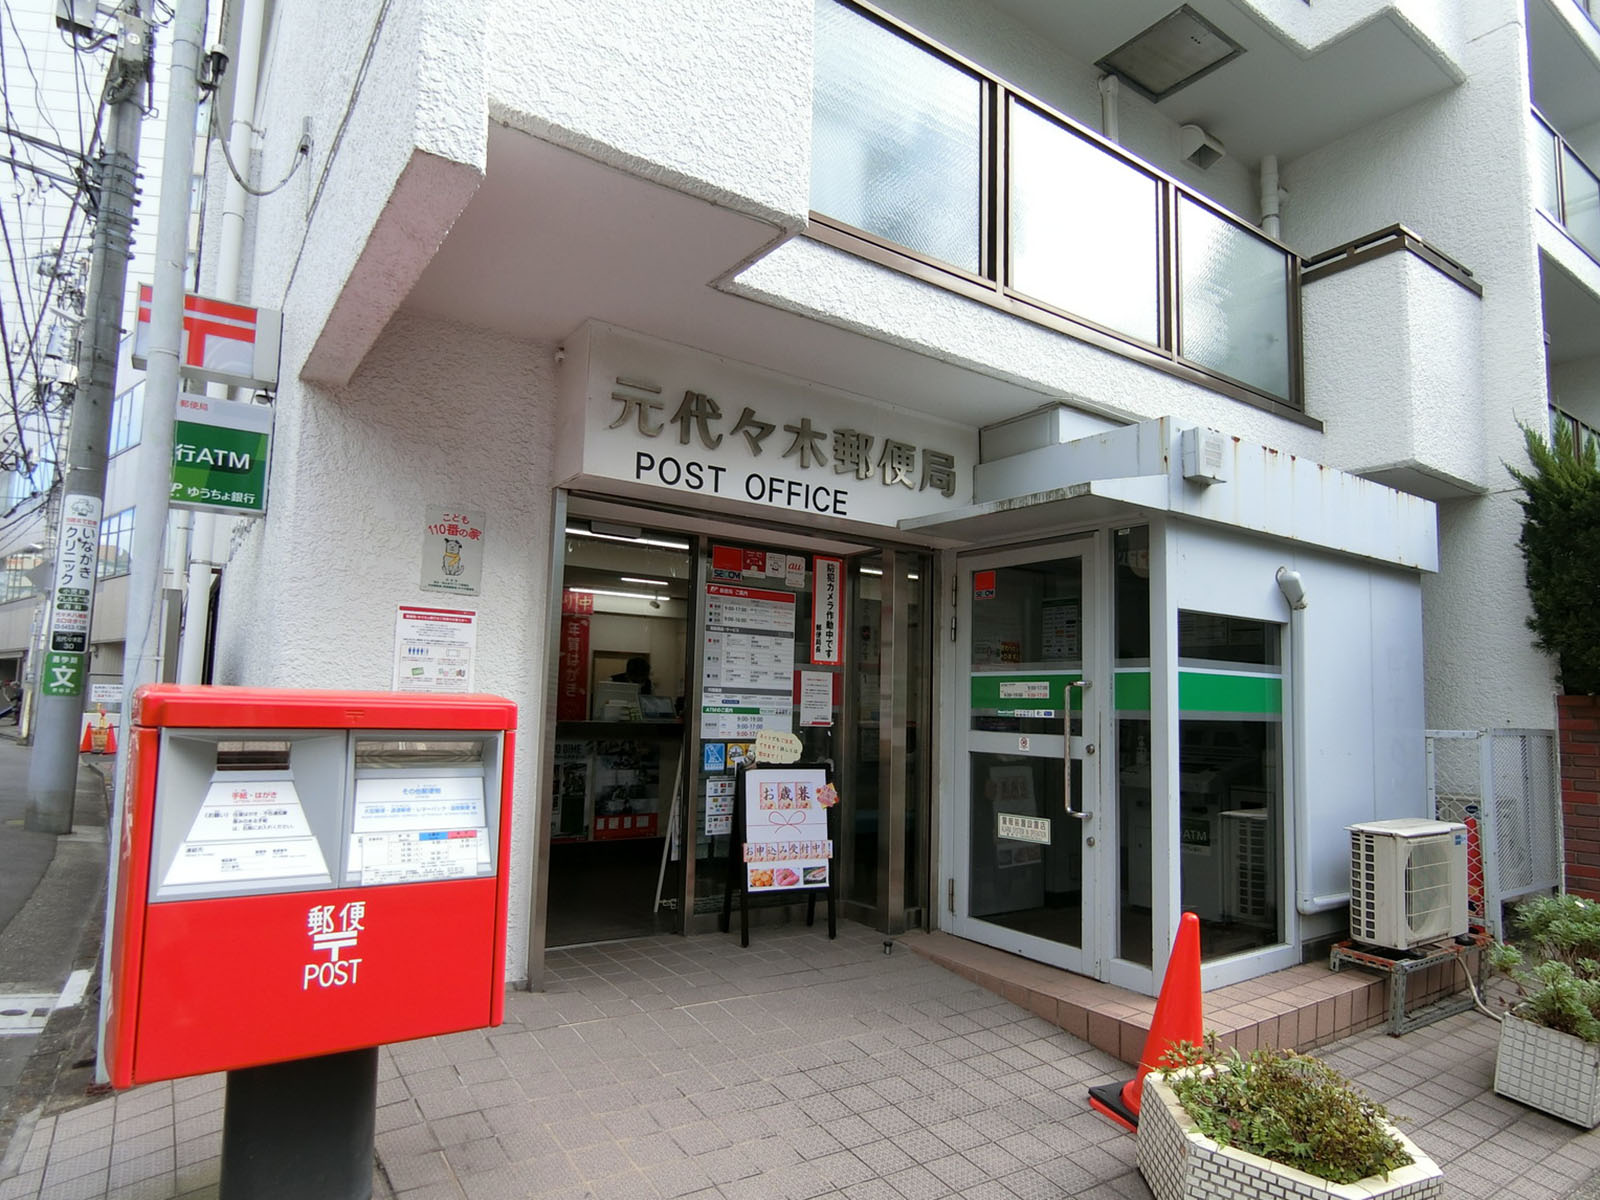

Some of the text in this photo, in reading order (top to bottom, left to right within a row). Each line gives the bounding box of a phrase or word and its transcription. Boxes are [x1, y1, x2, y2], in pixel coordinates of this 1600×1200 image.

[180, 400, 208, 411] 郵便局
[609, 376, 956, 497] 元代々木郵便局
[187, 486, 256, 504] ゆうちょ銀行
[635, 451, 848, 516] POST OFFICE
[442, 512, 470, 525] こども
[427, 523, 482, 540] 110番の家
[61, 526, 78, 585] クリニック
[80, 528, 95, 579] いながき
[825, 562, 835, 659] 防犯カメラ作動中です
[63, 642, 75, 650] 30
[49, 665, 77, 688] 文
[764, 785, 811, 801] お歳暮
[1183, 829, 1207, 841] ATM
[307, 901, 366, 936] 郵便
[303, 958, 363, 990] POST
